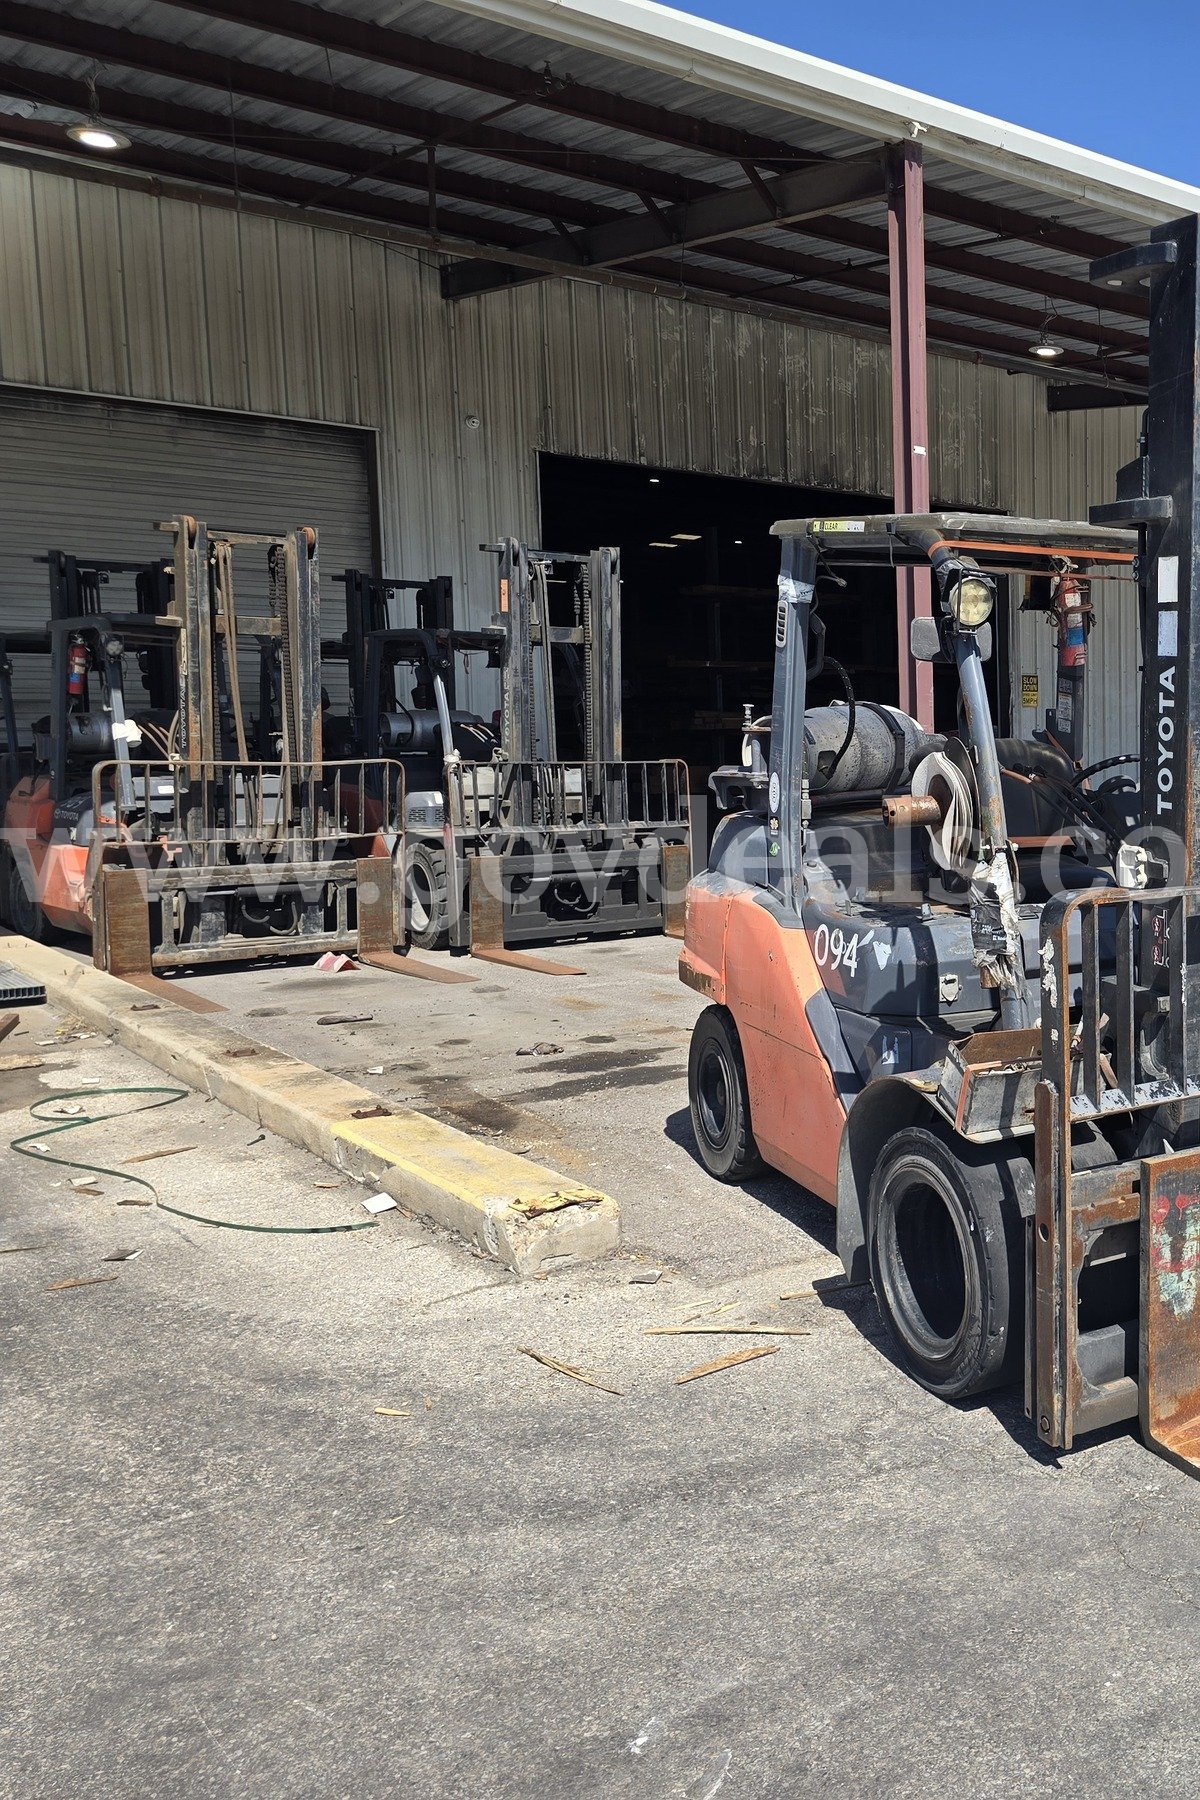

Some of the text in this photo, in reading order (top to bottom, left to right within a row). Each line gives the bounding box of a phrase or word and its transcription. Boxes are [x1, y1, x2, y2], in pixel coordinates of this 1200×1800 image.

[1023, 676, 1037, 684] SLOW
[1157, 666, 1175, 814] TOYOTA
[61, 810, 79, 820] TOYOTA
[814, 923, 858, 978] 094
